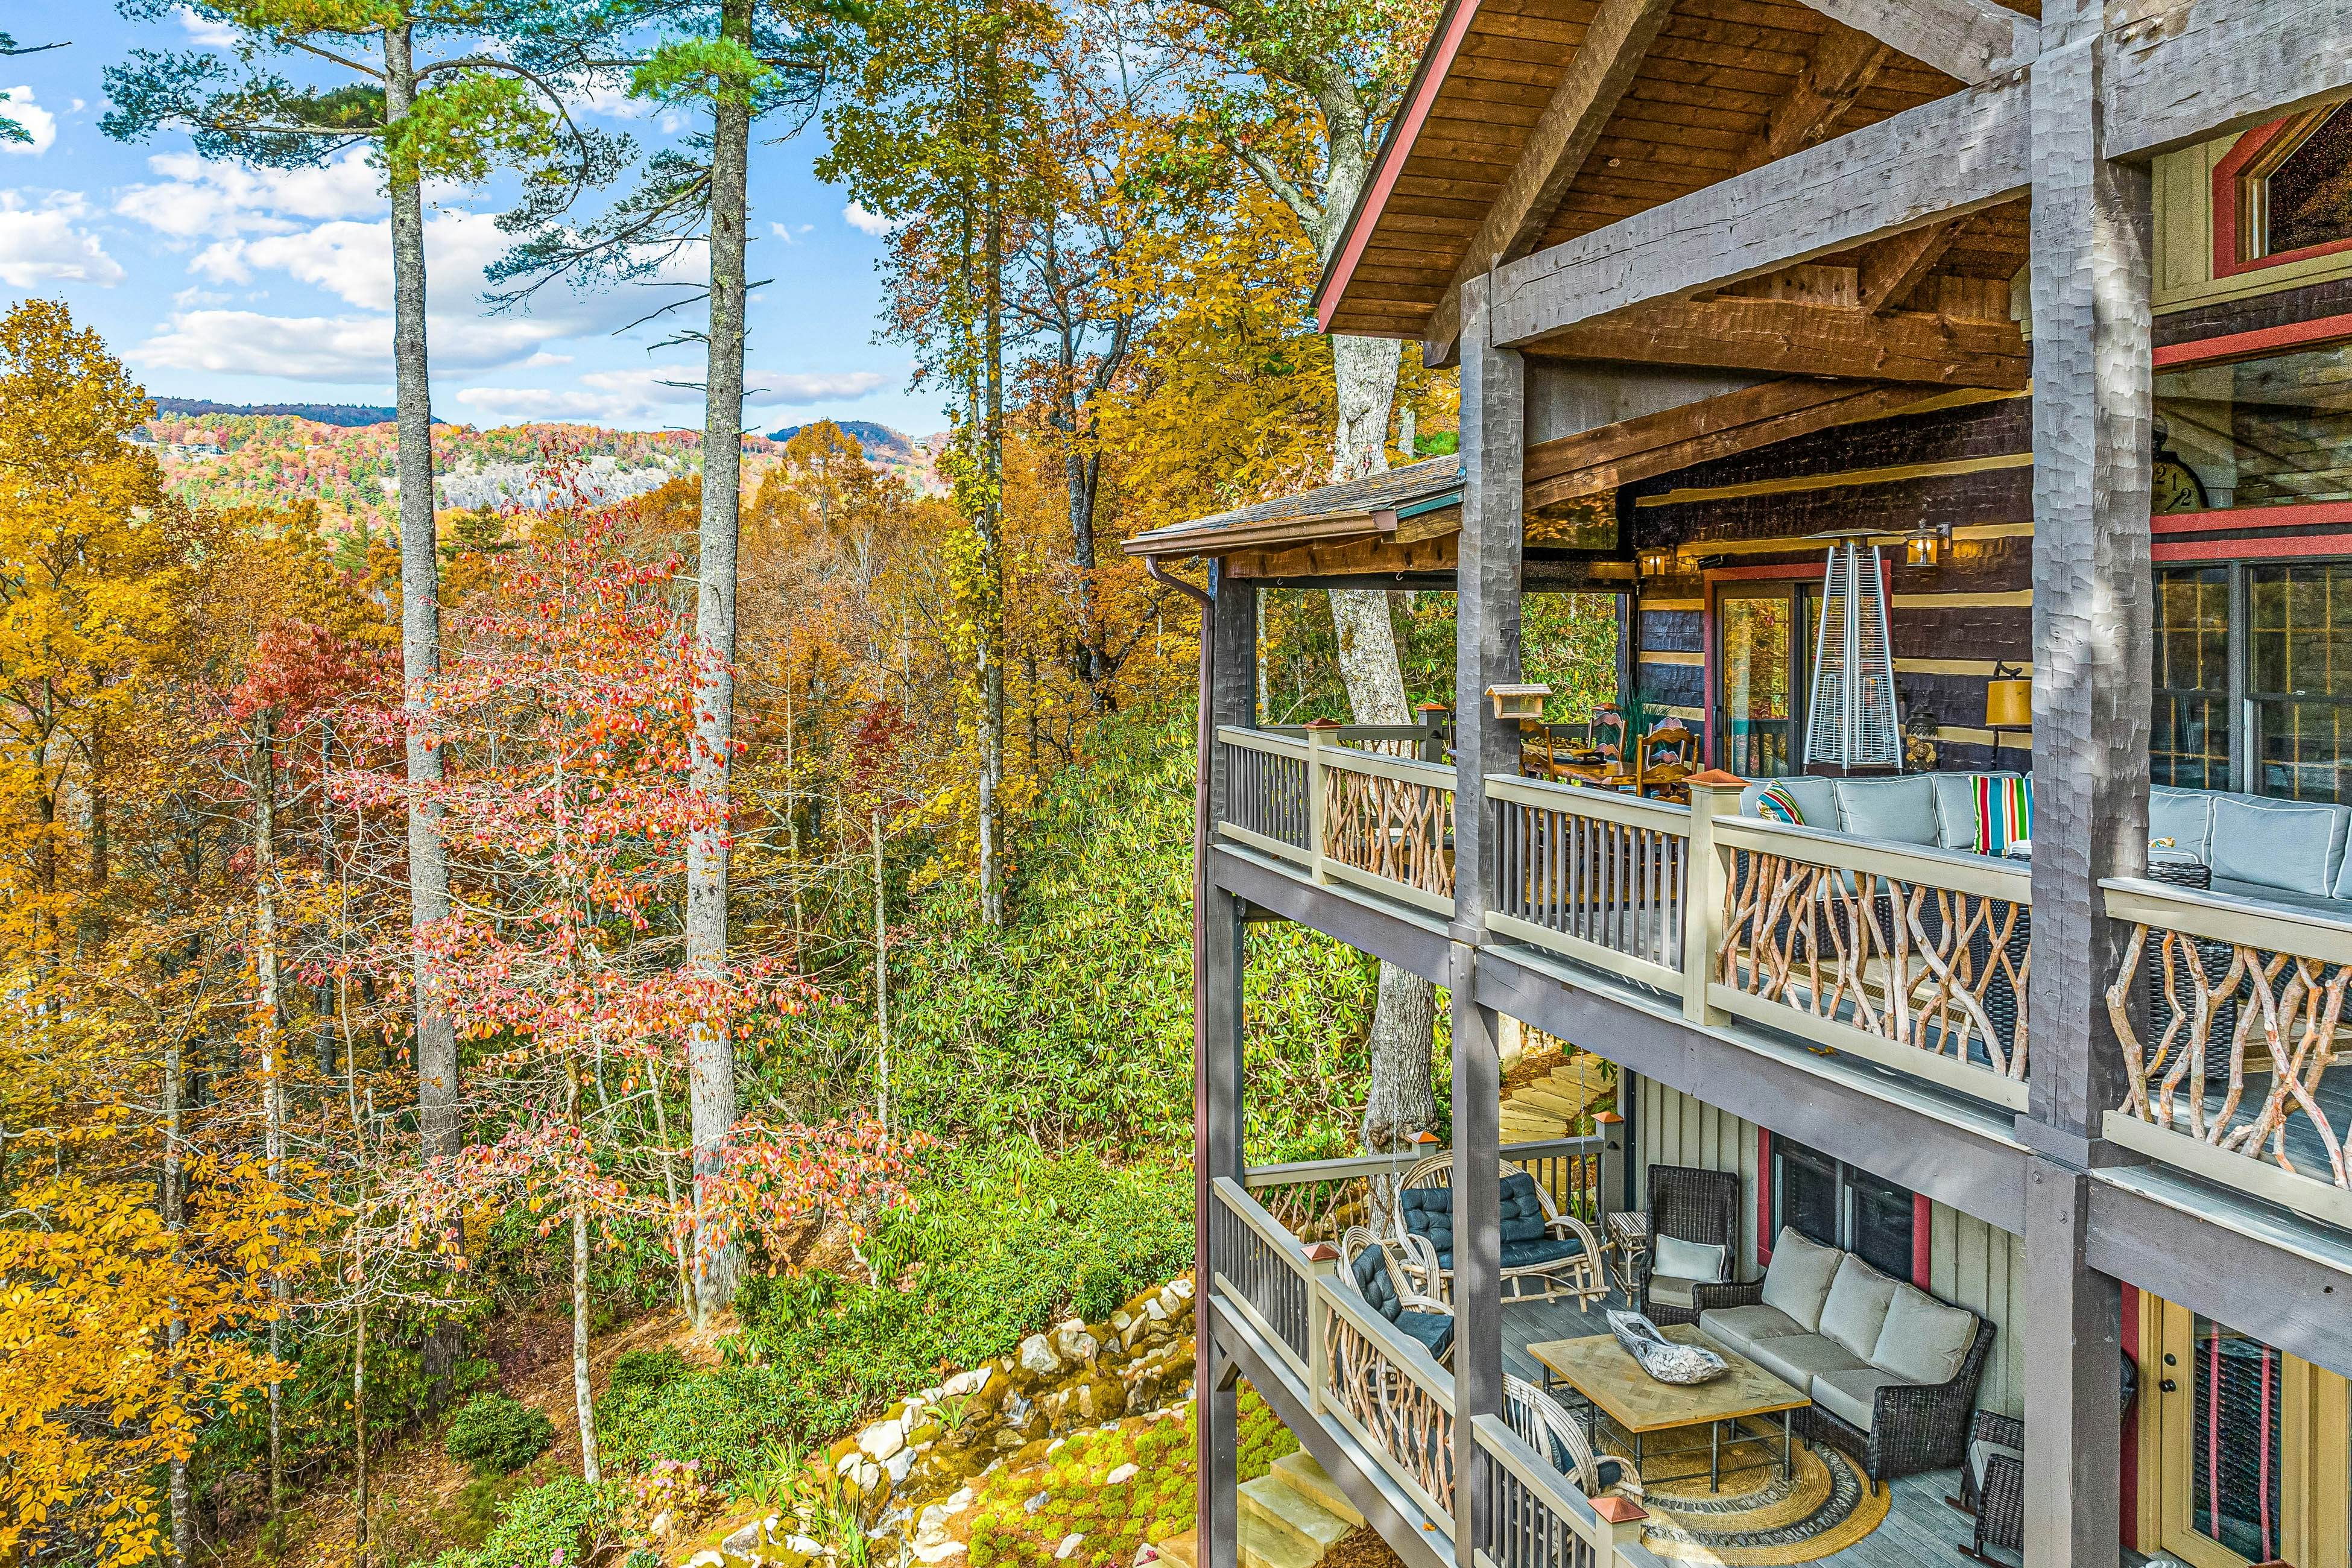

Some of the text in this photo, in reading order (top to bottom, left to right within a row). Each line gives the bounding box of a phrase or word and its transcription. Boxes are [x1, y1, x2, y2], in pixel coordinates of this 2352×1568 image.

[2152, 464, 2166, 484] 2
[2172, 472, 2177, 491] 1
[2181, 488, 2192, 506] 2
